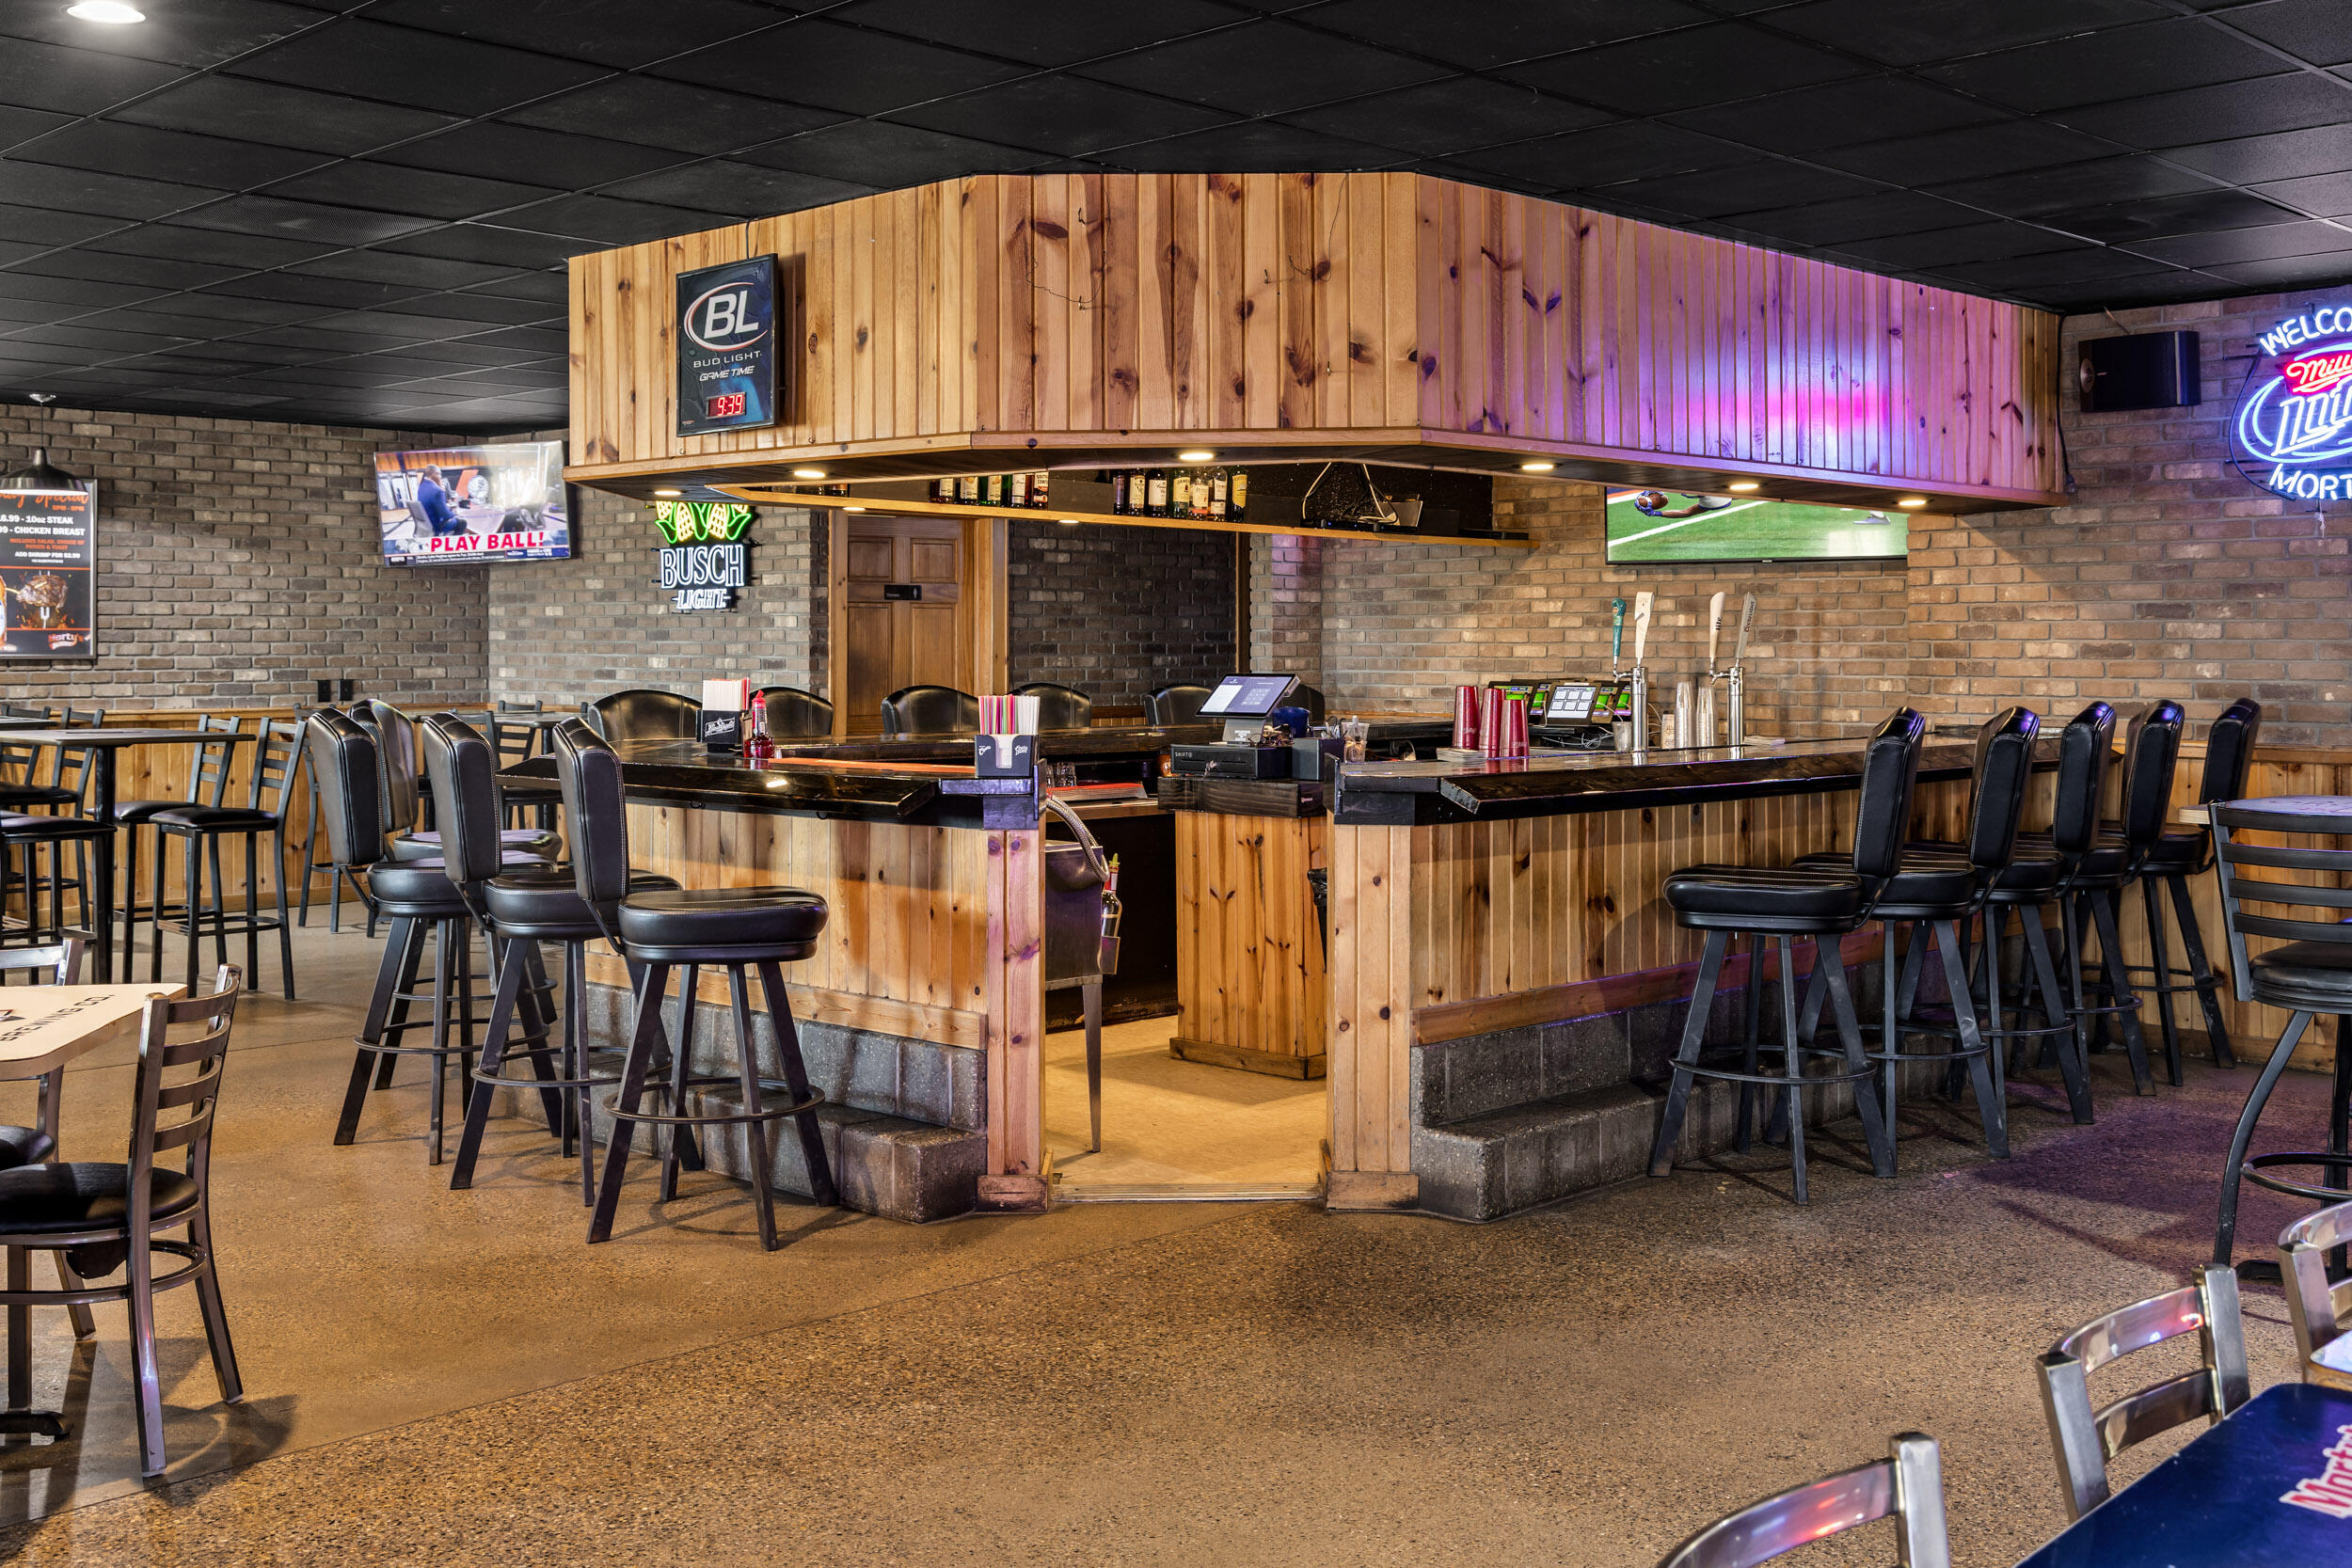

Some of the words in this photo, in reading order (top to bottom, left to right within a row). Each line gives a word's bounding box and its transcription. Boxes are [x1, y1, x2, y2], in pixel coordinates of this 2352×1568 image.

[704, 290, 759, 340] BL
[693, 357, 721, 368] BUD
[723, 350, 761, 364] LIGHT
[2286, 354, 2352, 385] Mill
[699, 370, 730, 382] GAME
[731, 365, 755, 377] TIME
[25, 515, 46, 524] 10oz
[47, 516, 74, 525] STEAK
[53, 528, 86, 536] BREAST
[431, 534, 481, 552] PLAY
[487, 531, 545, 549] BALL!
[660, 544, 745, 589] BUSCH
[676, 588, 728, 610] LIGHT
